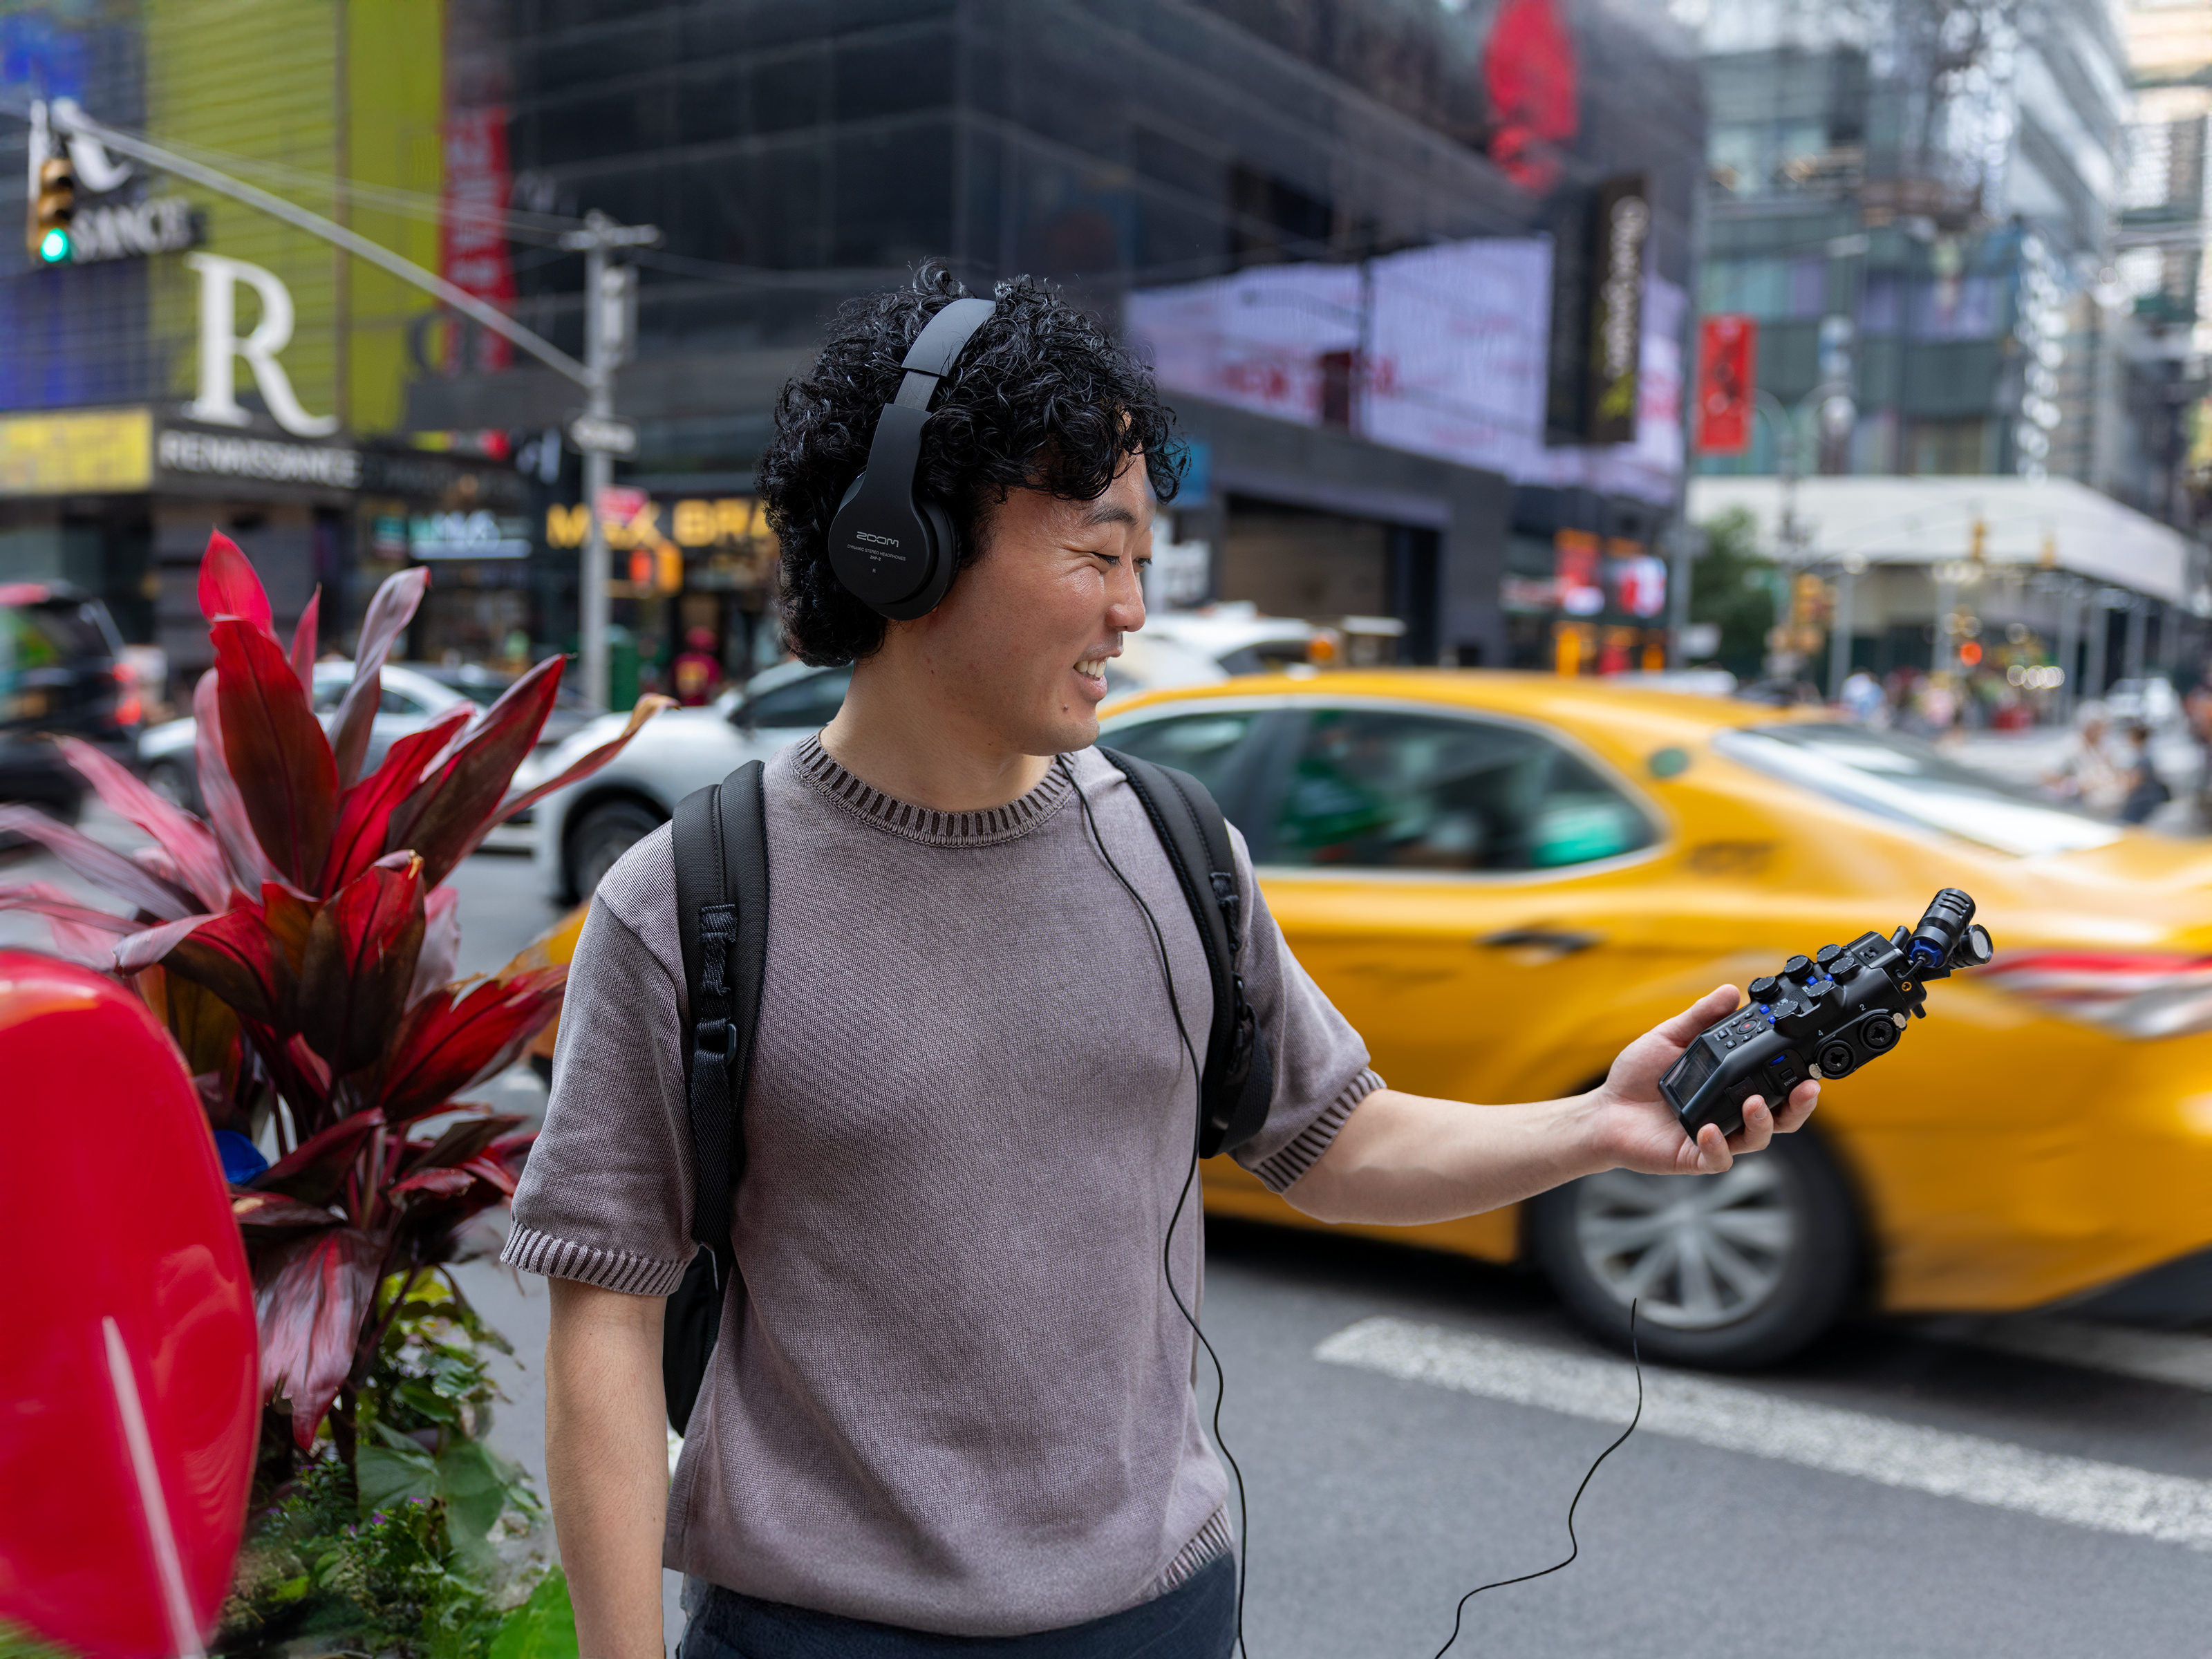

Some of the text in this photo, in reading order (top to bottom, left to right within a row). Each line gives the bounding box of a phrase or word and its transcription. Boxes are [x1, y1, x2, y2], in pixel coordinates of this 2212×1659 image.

[184, 250, 338, 437] R
[856, 531, 899, 547] ZOOM
[847, 544, 865, 552] DYNAMIC
[879, 552, 906, 561] HEADPHONES
[1783, 1076, 1799, 1087] ENTER
